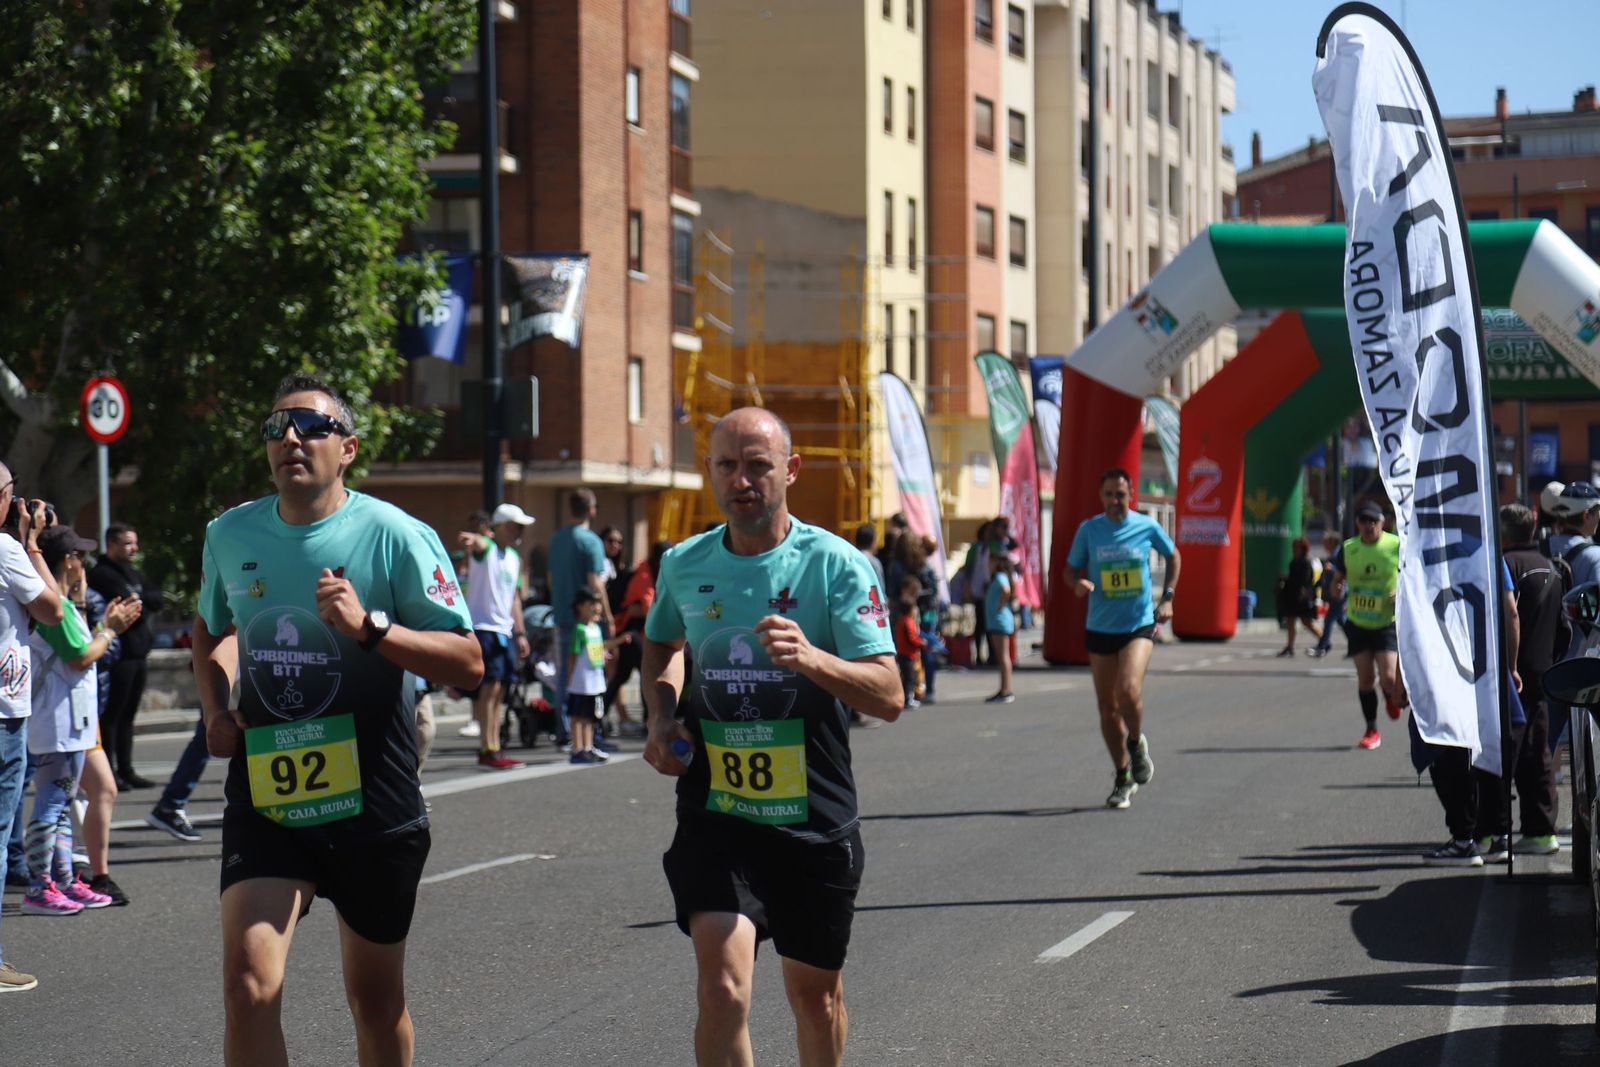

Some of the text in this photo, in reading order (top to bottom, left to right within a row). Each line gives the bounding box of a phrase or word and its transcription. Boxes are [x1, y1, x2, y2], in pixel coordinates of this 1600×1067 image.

[92, 399, 120, 419] 30
[1111, 572, 1129, 587] 81
[1354, 595, 1377, 611] 100
[252, 649, 328, 666] CABRONES
[273, 664, 303, 677] BTT
[705, 668, 783, 683] CABRONES
[727, 682, 758, 694] BTT
[271, 751, 330, 796] 92
[722, 752, 774, 792] 88
[287, 798, 358, 820] CAJA RURAL
[736, 802, 802, 817] CAJA RURAL
